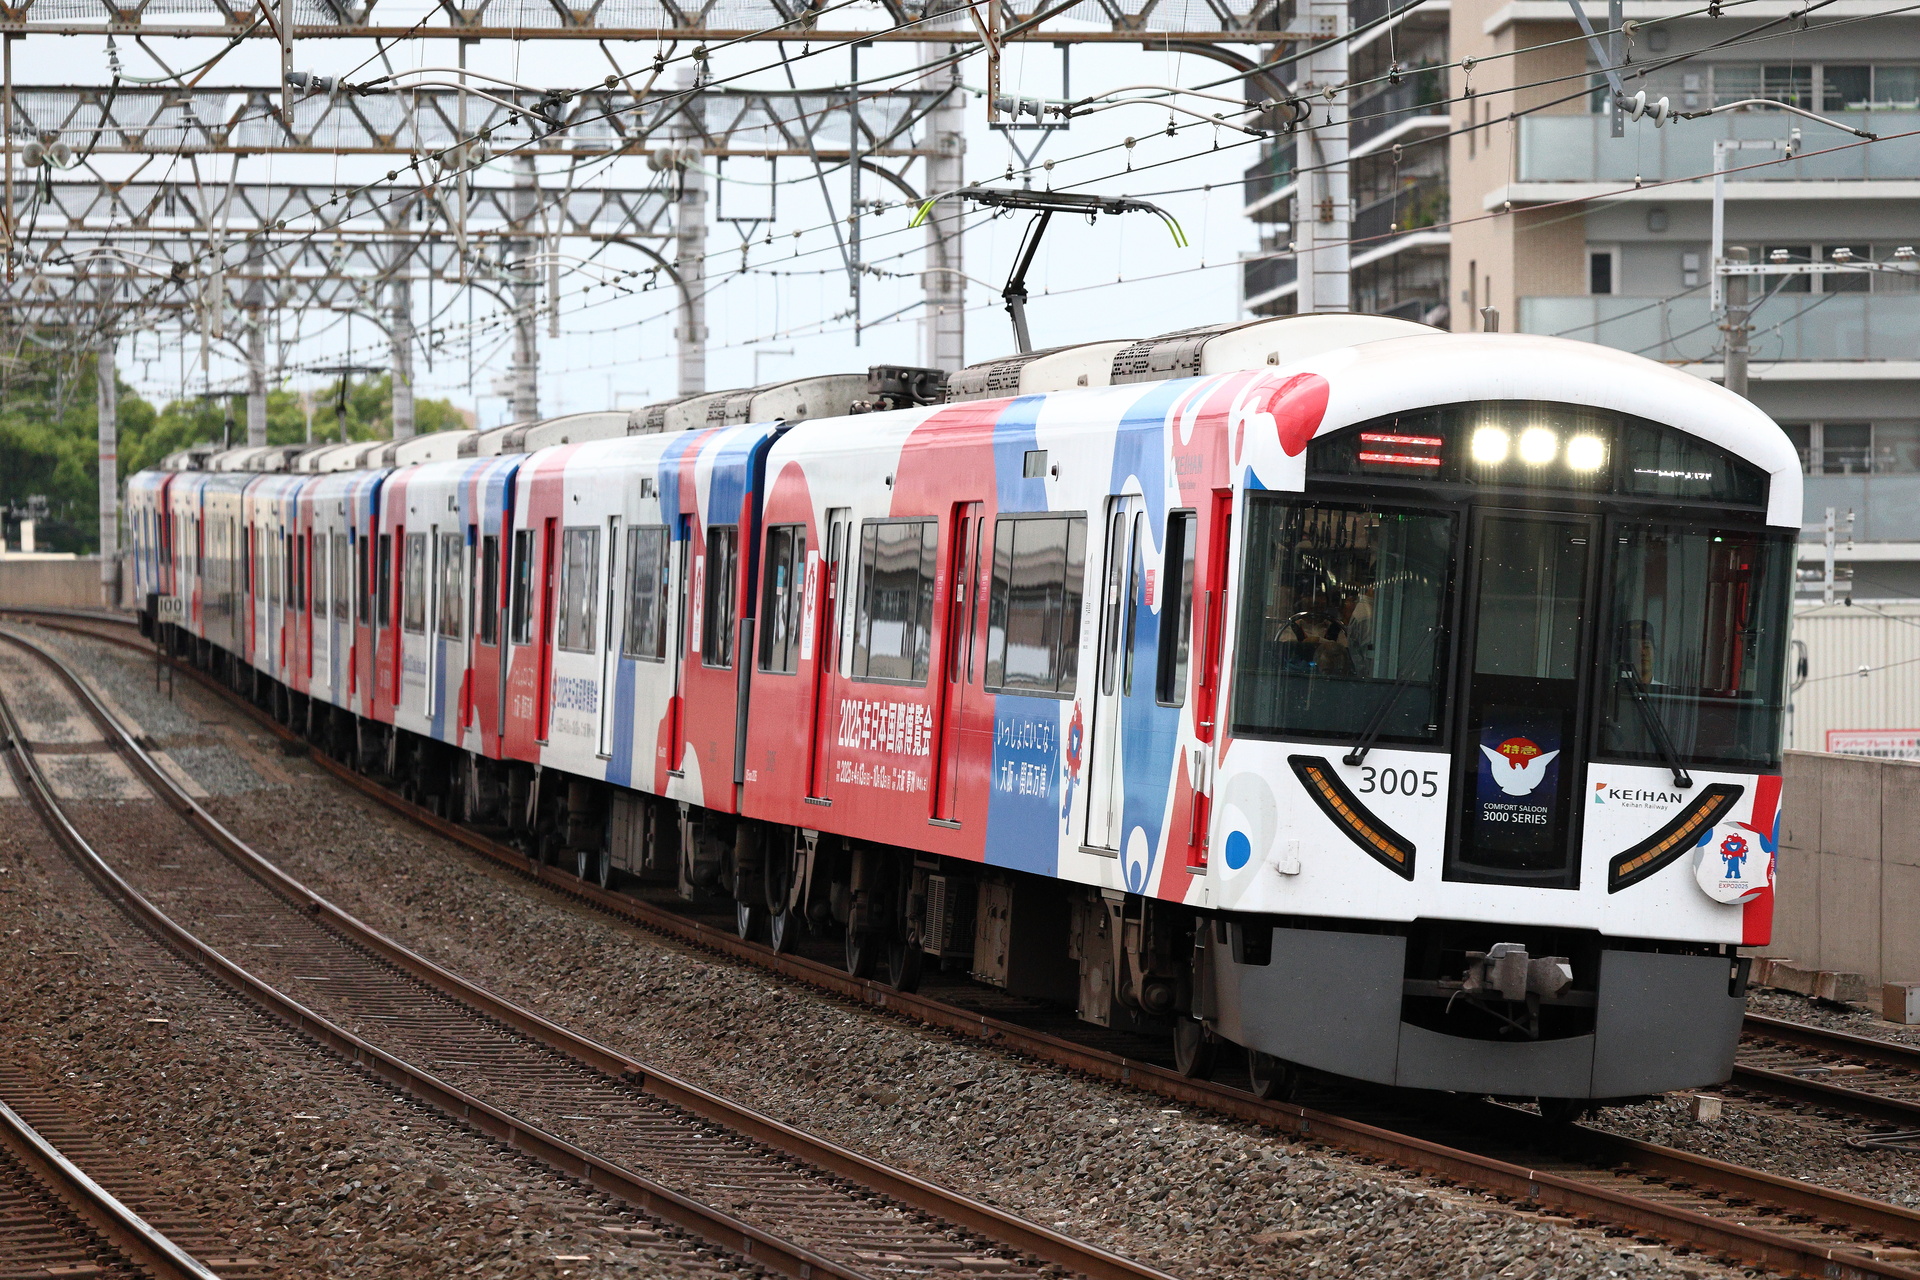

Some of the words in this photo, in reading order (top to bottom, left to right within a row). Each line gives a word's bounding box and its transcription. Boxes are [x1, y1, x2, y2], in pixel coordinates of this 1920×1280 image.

[160, 599, 182, 613] 100
[838, 699, 932, 756] 2025年日本国際博覧会
[1503, 744, 1537, 755] 特急
[1000, 759, 1047, 798] 大阪・関西万博
[1359, 766, 1438, 797] 3005
[1609, 788, 1682, 804] KEIHAN
[1483, 802, 1518, 811] COMFORT
[1518, 805, 1548, 813] SALOON
[1644, 803, 1668, 811] Railway
[1482, 811, 1509, 822] 3000
[1511, 813, 1547, 825] SERIES
